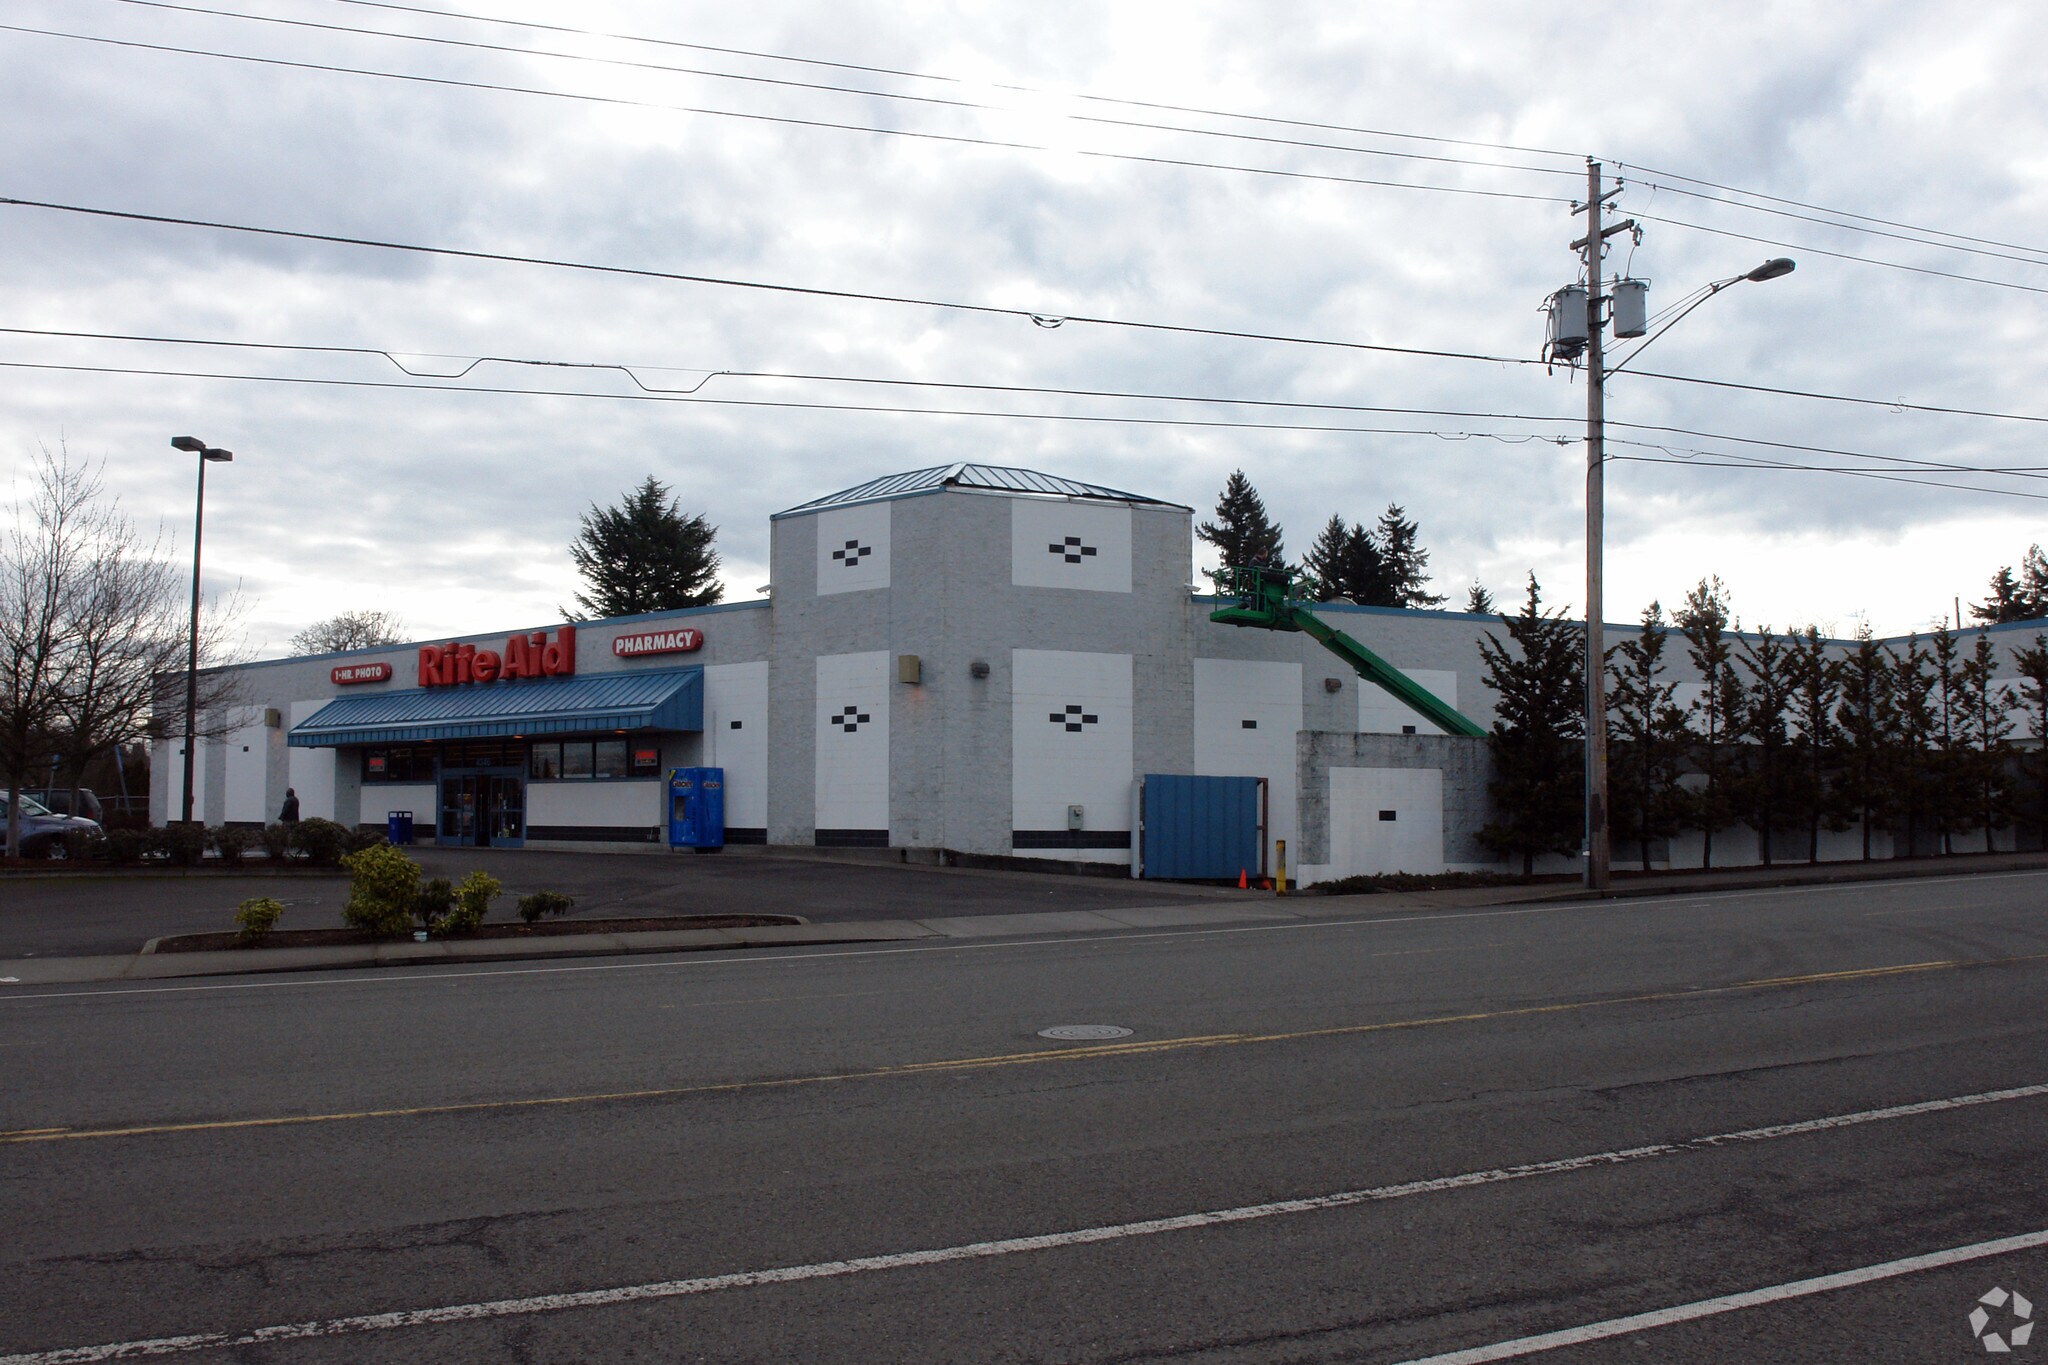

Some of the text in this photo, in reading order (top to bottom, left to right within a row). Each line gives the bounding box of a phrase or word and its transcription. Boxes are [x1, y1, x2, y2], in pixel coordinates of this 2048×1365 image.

[616, 631, 694, 654] PHARMACY
[418, 625, 576, 687] Rite Aid
[355, 666, 382, 679] PHOTO
